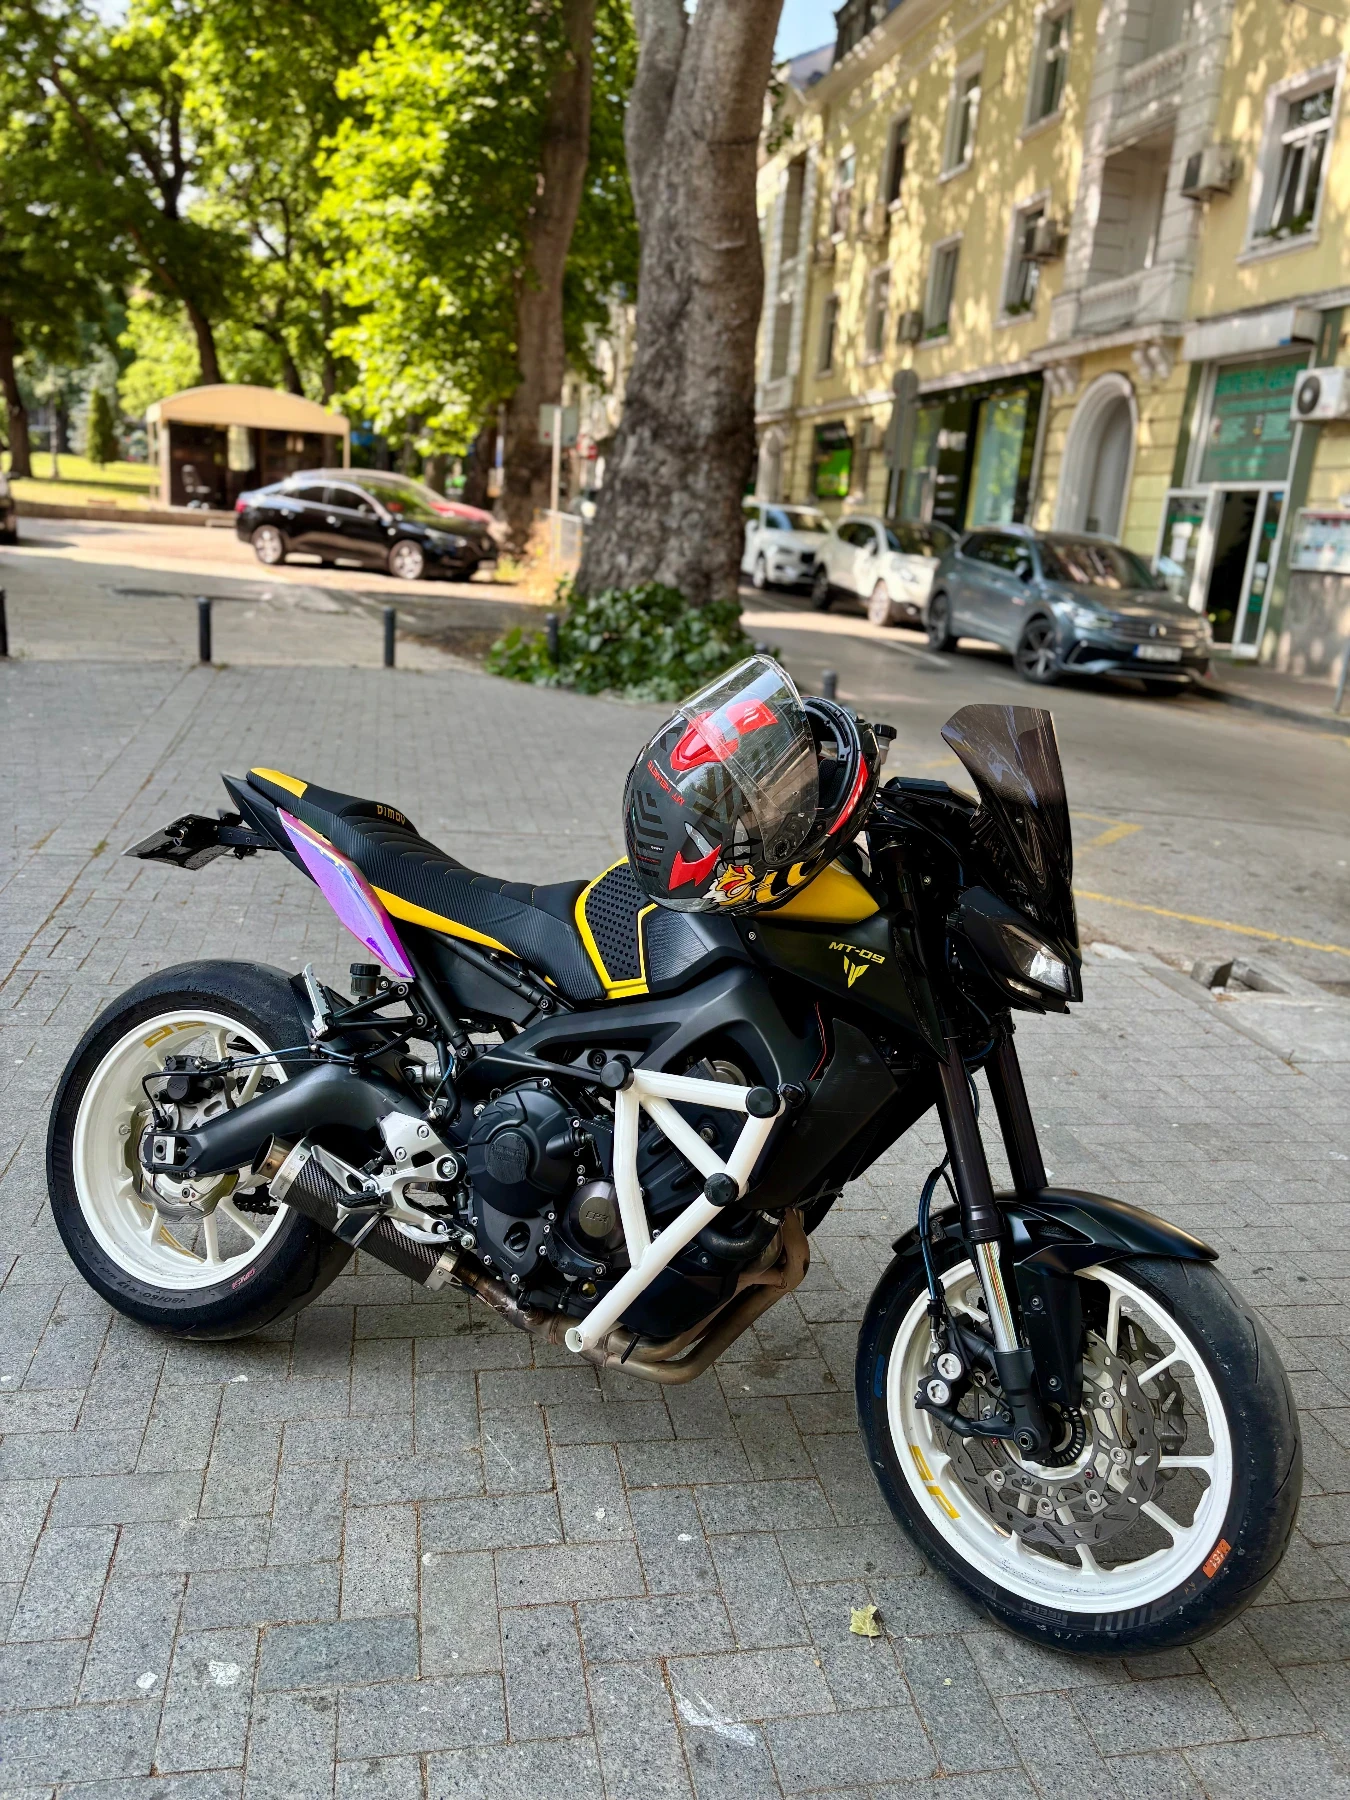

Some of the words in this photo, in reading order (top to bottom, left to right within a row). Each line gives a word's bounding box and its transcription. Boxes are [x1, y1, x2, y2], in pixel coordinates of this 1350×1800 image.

[647, 759, 672, 794] HELMETS
[671, 792, 685, 806] MT
[376, 804, 406, 825] DIMOV
[828, 941, 886, 965] MT-09
